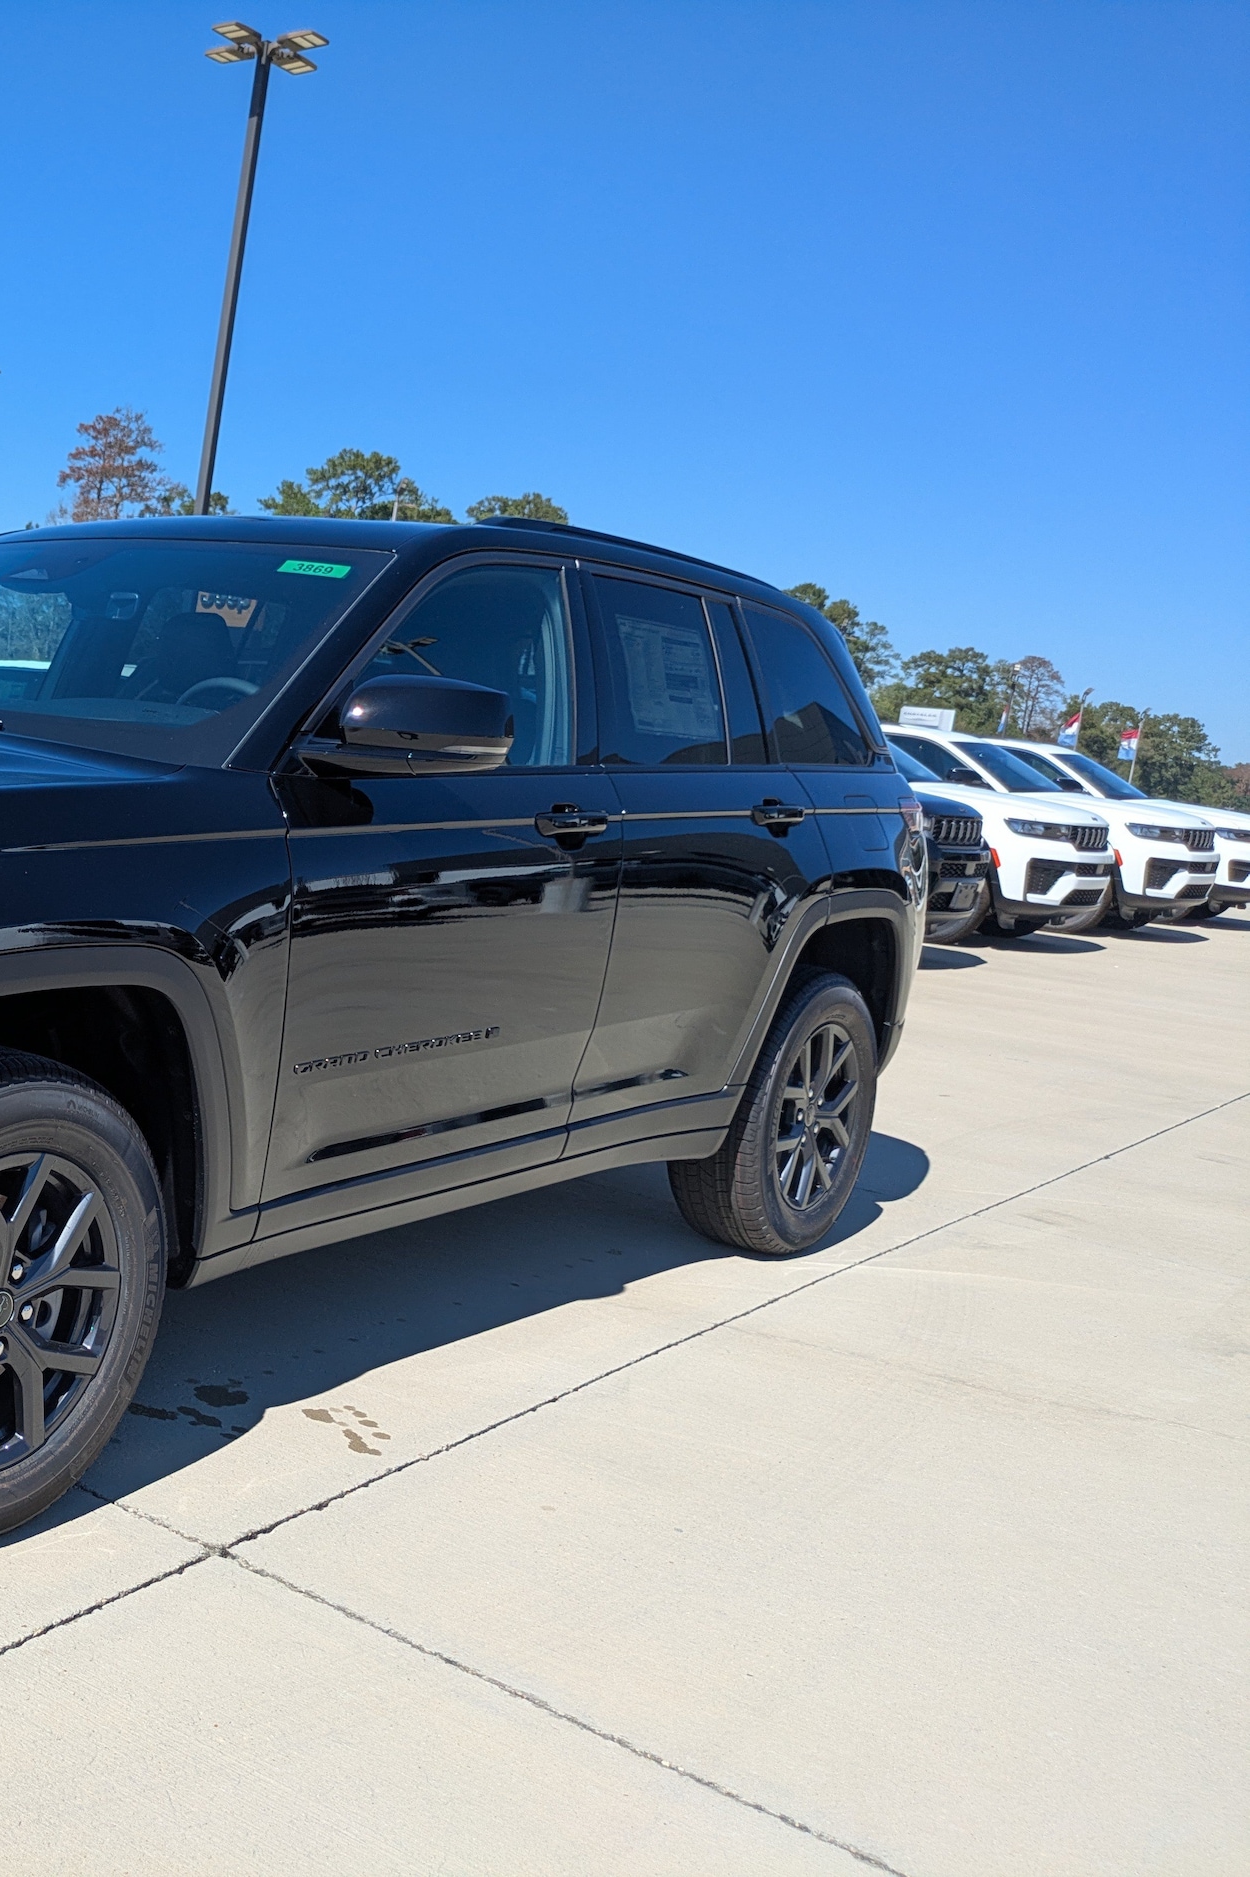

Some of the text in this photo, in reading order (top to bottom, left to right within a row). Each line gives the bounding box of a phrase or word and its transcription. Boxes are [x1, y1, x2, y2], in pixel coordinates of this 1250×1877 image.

[292, 562, 334, 575] 3869
[293, 1029, 483, 1075] GRAND CHEROKEE
[127, 1263, 159, 1382] MICHELIN
